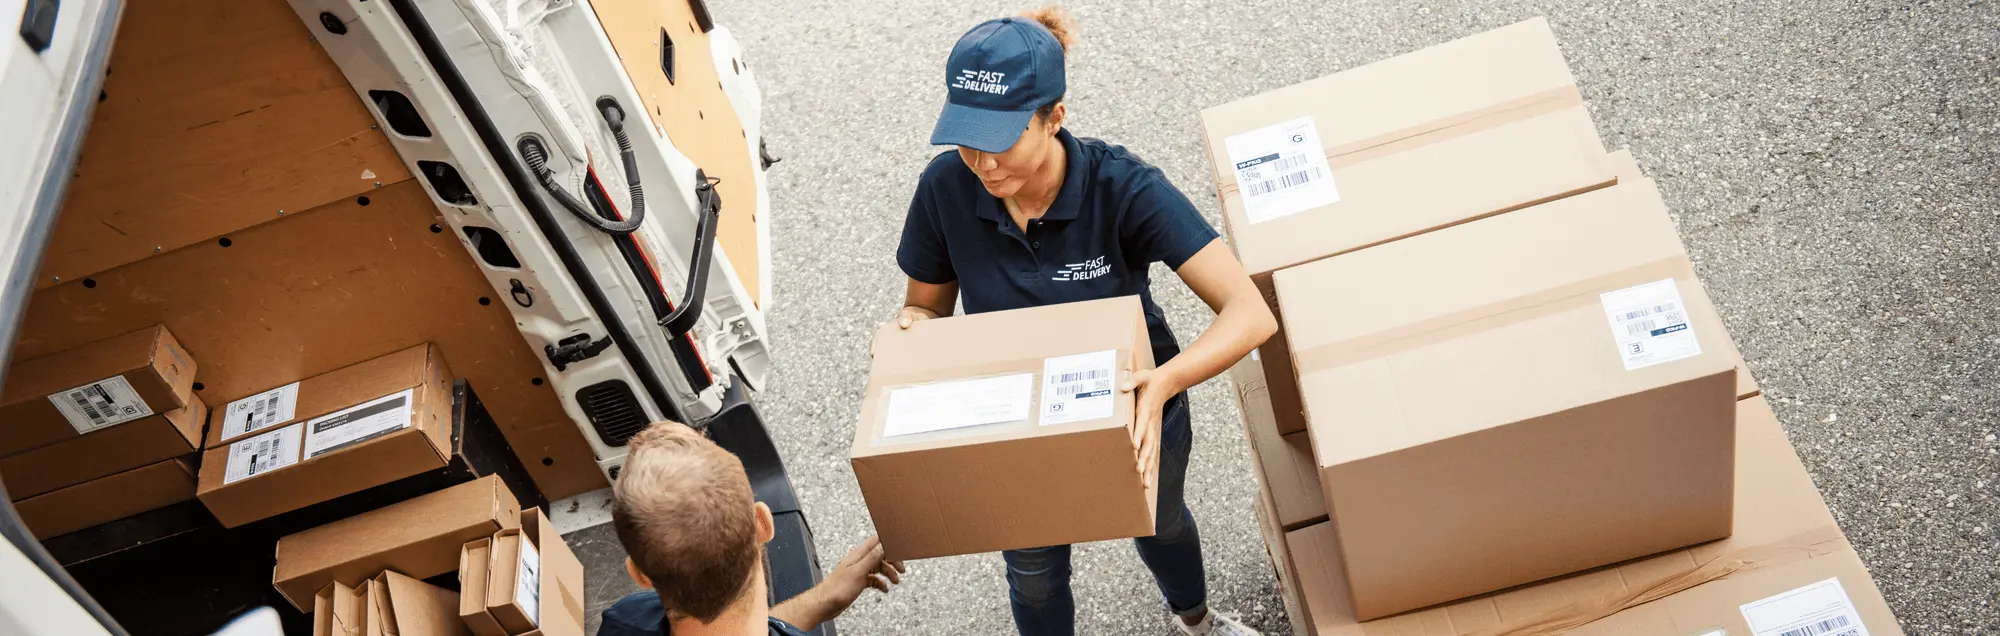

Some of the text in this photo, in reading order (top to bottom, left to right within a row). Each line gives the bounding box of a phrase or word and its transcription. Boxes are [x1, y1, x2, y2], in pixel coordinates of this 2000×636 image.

[977, 70, 1005, 84] FAST
[964, 79, 1009, 95] DELIVERY
[1292, 134, 1303, 143] G
[1085, 255, 1105, 270] FAST
[1073, 264, 1111, 281] DELIVERY
